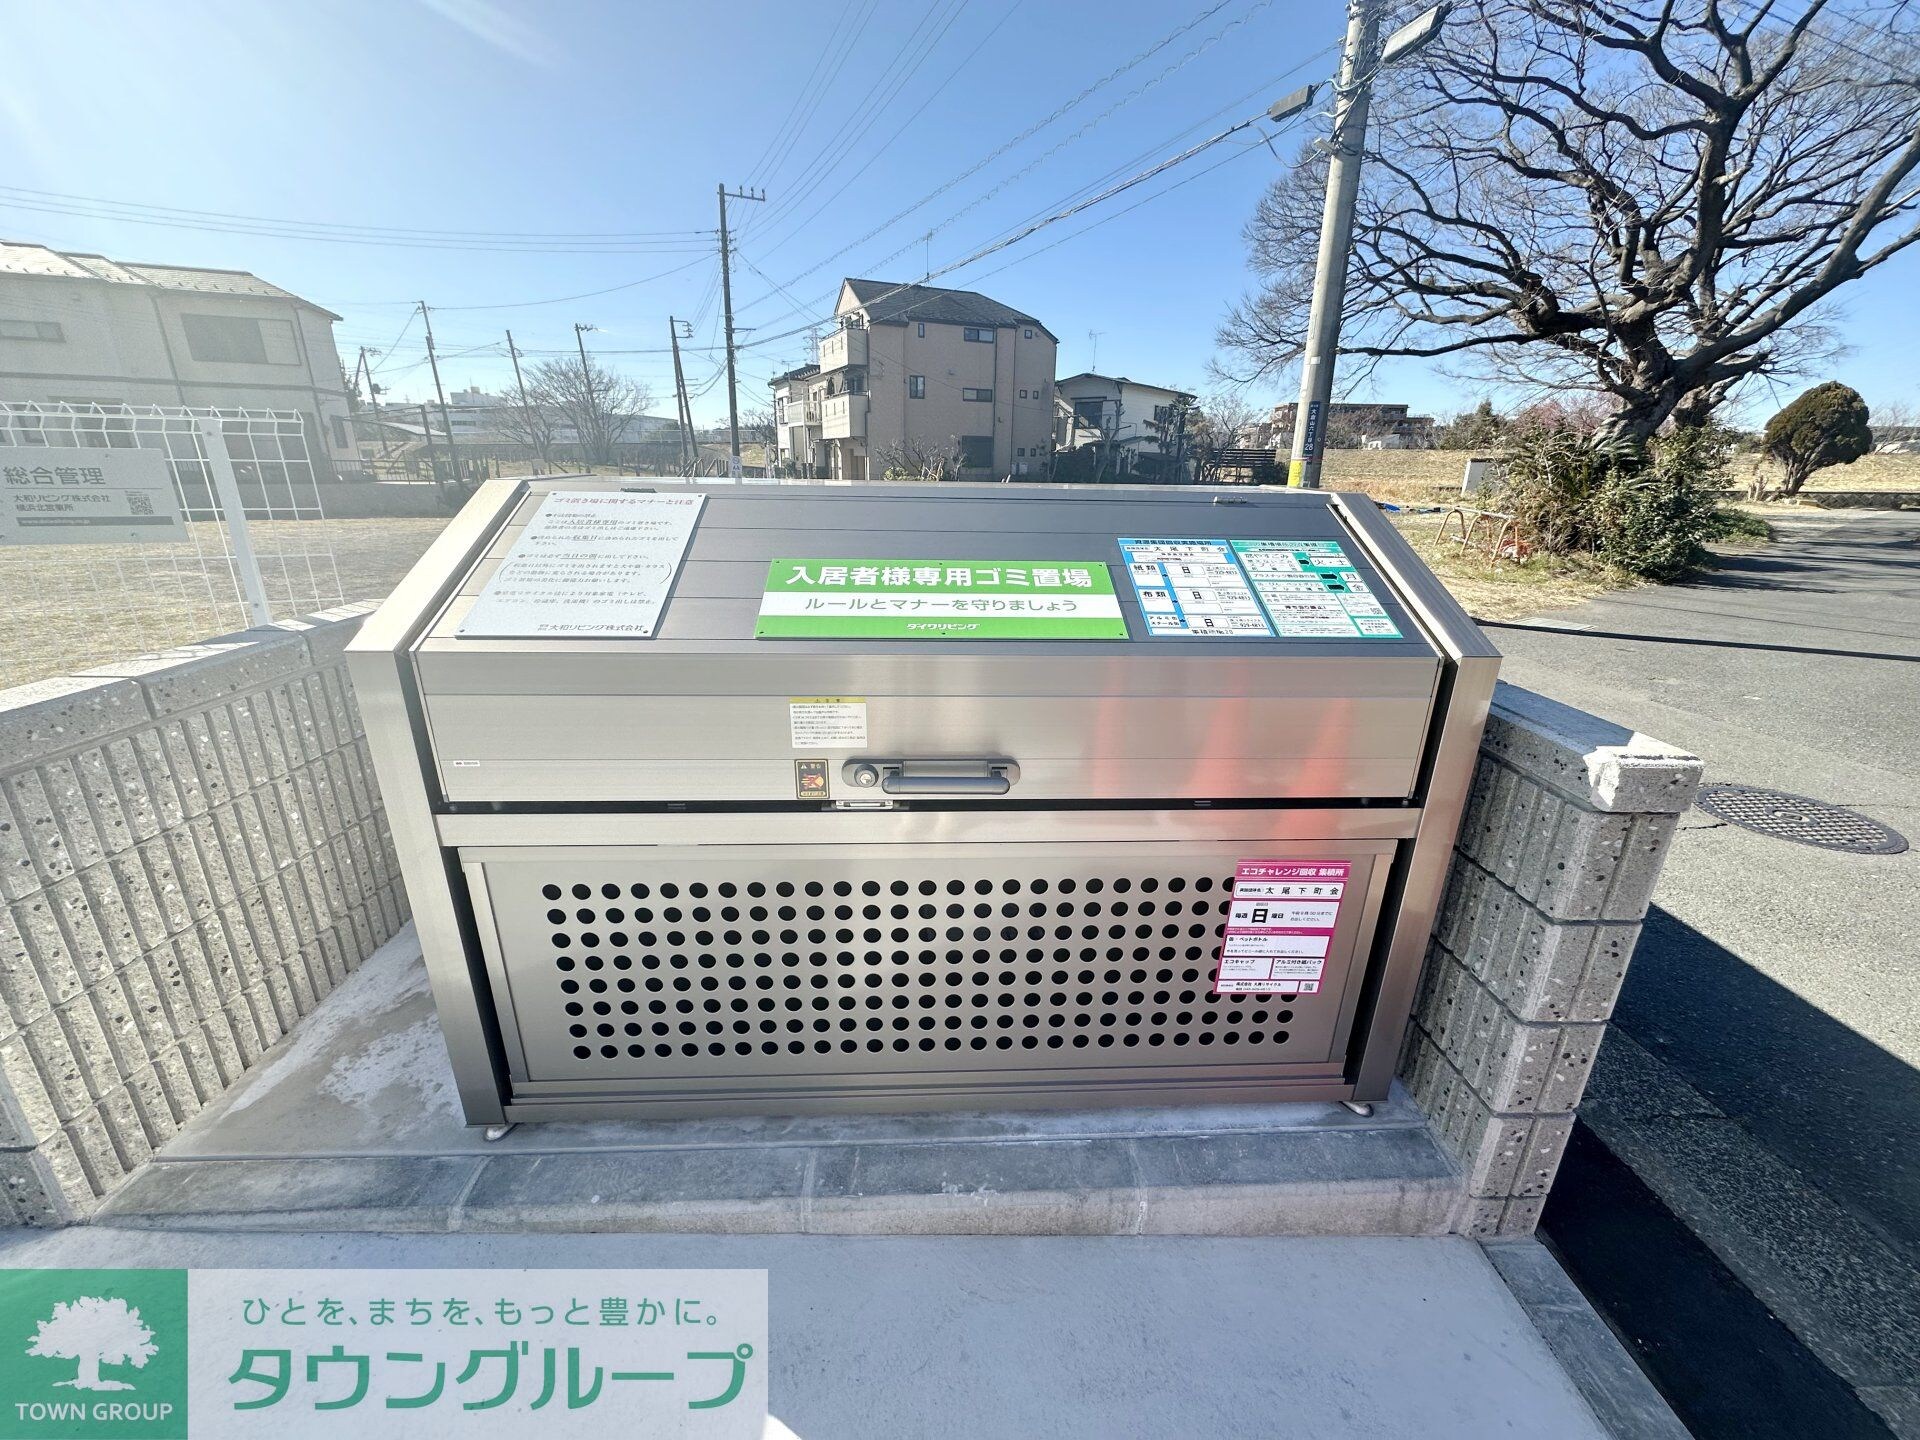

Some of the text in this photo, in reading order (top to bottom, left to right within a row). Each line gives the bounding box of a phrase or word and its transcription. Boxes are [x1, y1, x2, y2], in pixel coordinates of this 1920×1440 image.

[3, 466, 106, 485] 総合管理
[1182, 566, 1190, 574] 日
[785, 566, 1092, 588] 入居者様専用ゴミ置場
[1192, 592, 1202, 600] 日
[805, 598, 1078, 612] ルールとマナーを守りましょう
[1204, 618, 1214, 627] 日
[549, 624, 644, 632] 大和リビング株式会社
[1242, 868, 1316, 876] エコチャレンジ回収
[1252, 909, 1268, 923] 日
